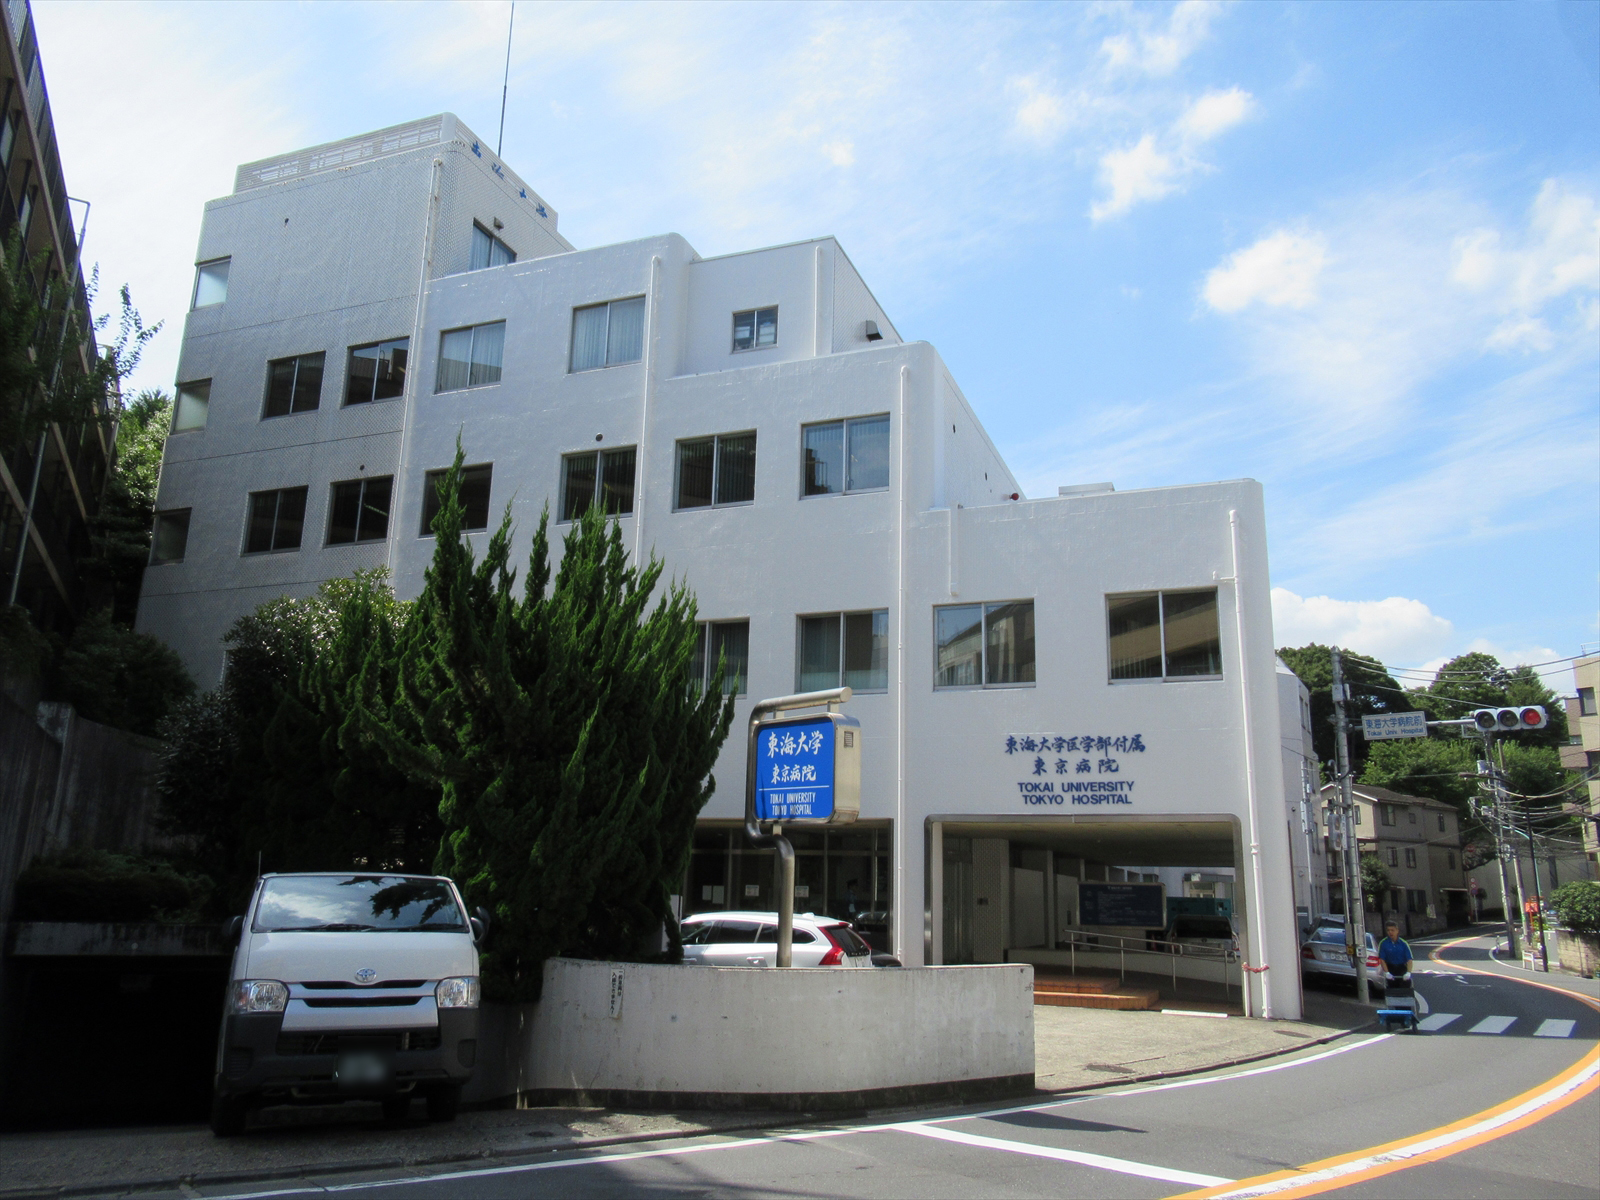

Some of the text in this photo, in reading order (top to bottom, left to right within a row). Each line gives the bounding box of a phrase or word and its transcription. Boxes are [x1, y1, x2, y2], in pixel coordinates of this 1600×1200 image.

[768, 730, 823, 758] 東海大学
[1005, 734, 1146, 757] 東海大学医学部付属
[771, 763, 817, 785] 東京病院
[1032, 756, 1119, 776] 東京病院
[1017, 781, 1135, 793] TOKAI UNIVERSITY
[770, 792, 817, 804] TOKAI UNIVERSITY
[1022, 793, 1133, 805] TOKYO HOSPITAL
[789, 803, 813, 815] HOSPITAL
